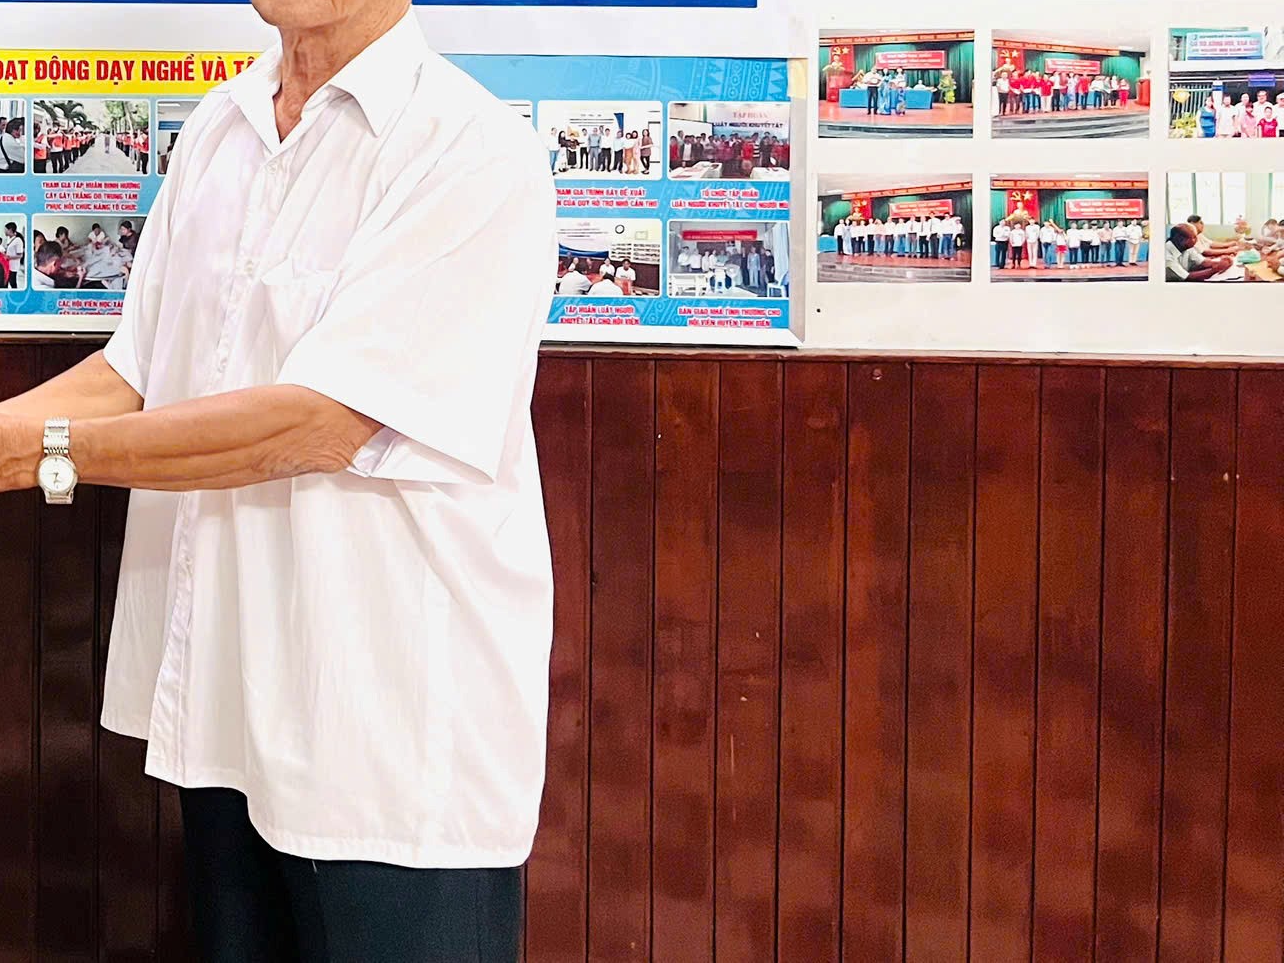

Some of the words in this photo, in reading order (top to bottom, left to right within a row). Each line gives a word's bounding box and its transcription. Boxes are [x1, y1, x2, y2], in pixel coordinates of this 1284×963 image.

[34, 55, 90, 85] ĐỘNG
[96, 60, 135, 85] DẠY
[141, 53, 195, 82] NGHỀ
[202, 55, 227, 82] VÀ
